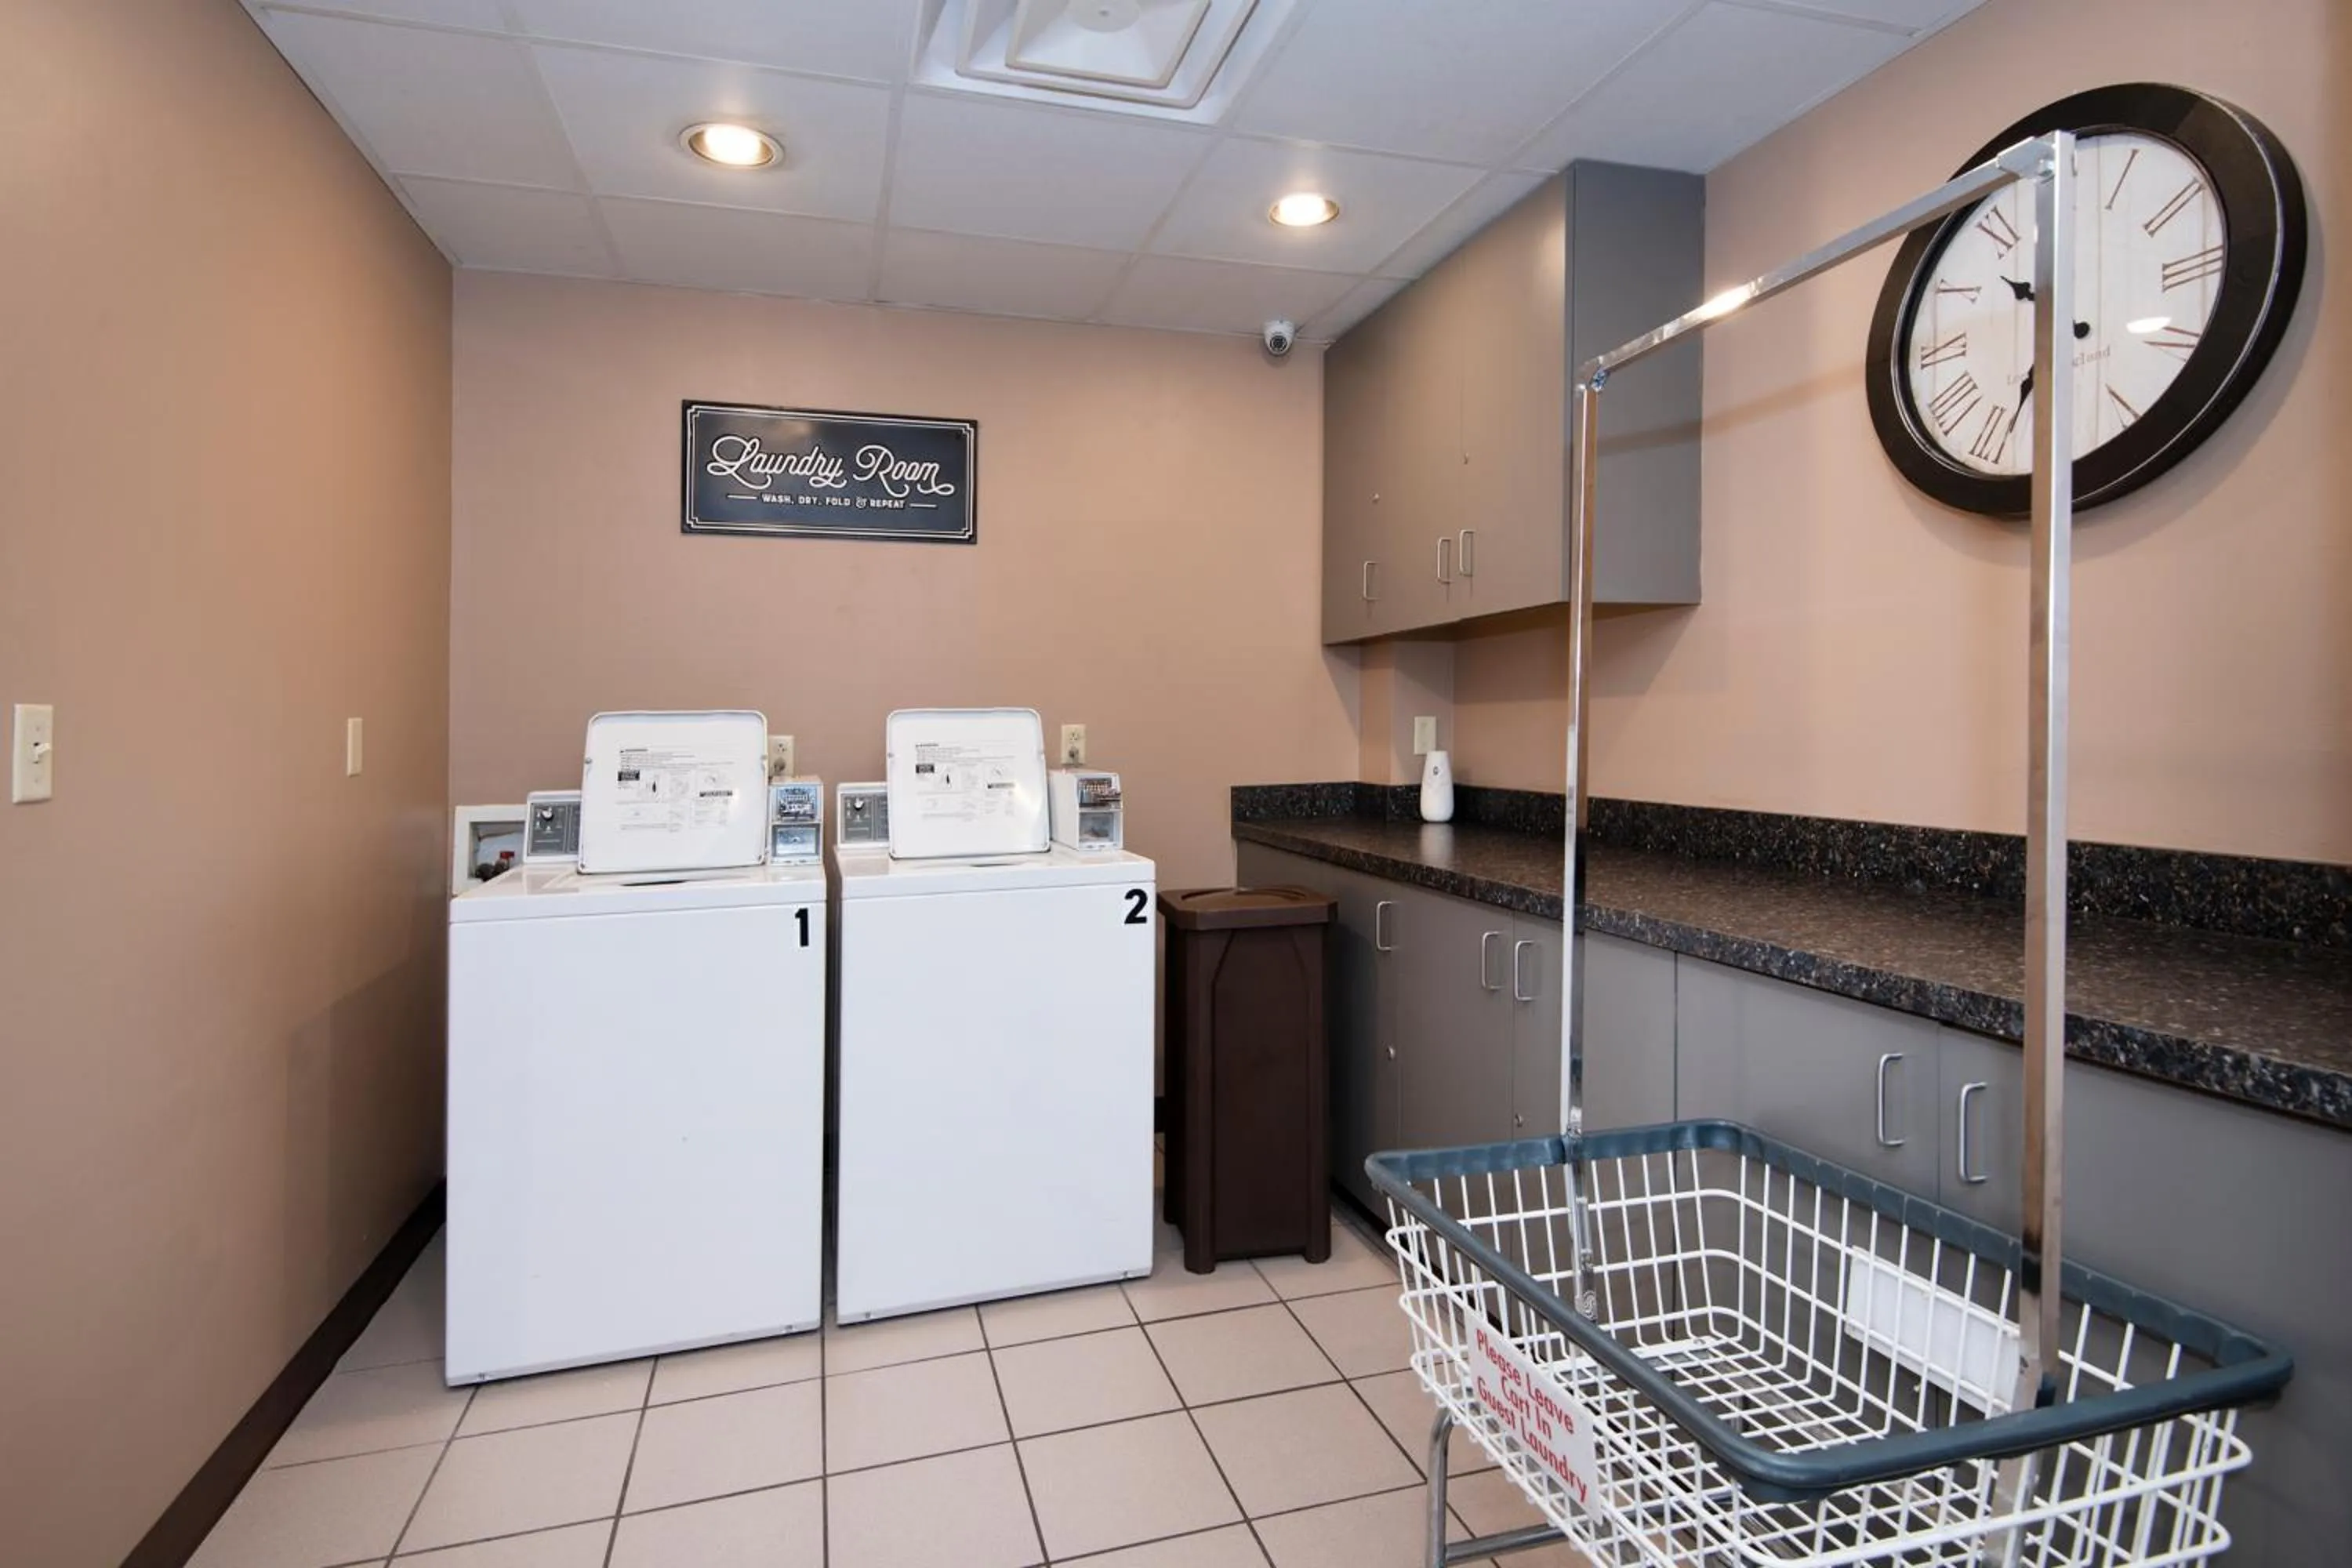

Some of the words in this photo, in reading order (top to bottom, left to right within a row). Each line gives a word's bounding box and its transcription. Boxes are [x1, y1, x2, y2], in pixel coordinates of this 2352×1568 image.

[706, 434, 848, 490] Laundry
[852, 445, 955, 498] Room
[826, 497, 851, 506] FOLD
[869, 499, 906, 509] REPEAT
[794, 908, 809, 947] 1
[1123, 889, 1148, 925] 2
[1476, 1329, 1522, 1387] Please
[1526, 1374, 1574, 1434] Leave
[1501, 1376, 1530, 1418] Cart
[1534, 1406, 1552, 1439] In
[1477, 1376, 1516, 1430] Guest
[1520, 1417, 1588, 1504] Laundry
